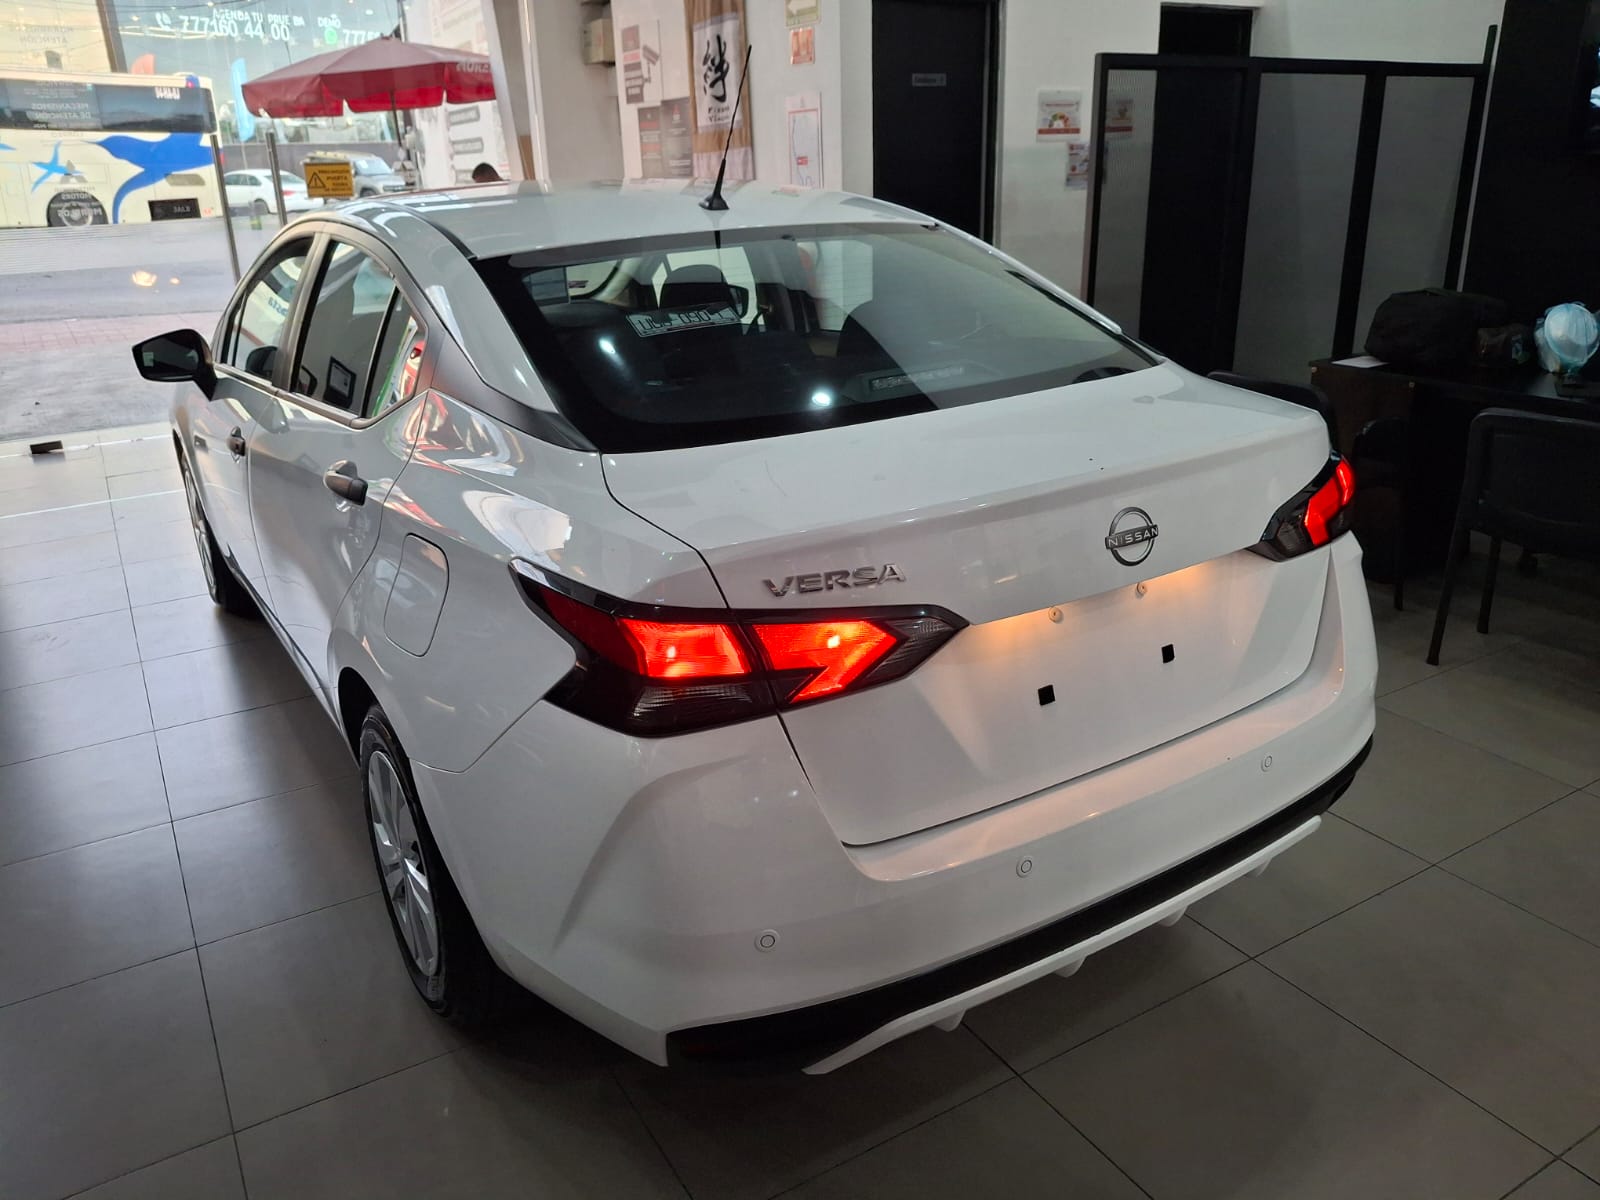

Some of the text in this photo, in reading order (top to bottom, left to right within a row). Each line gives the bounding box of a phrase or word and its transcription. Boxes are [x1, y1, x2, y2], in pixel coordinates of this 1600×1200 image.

[244, 21, 265, 39] 44
[271, 25, 290, 41] 00
[1108, 527, 1158, 547] NISSAN
[762, 563, 907, 598] VERSA
